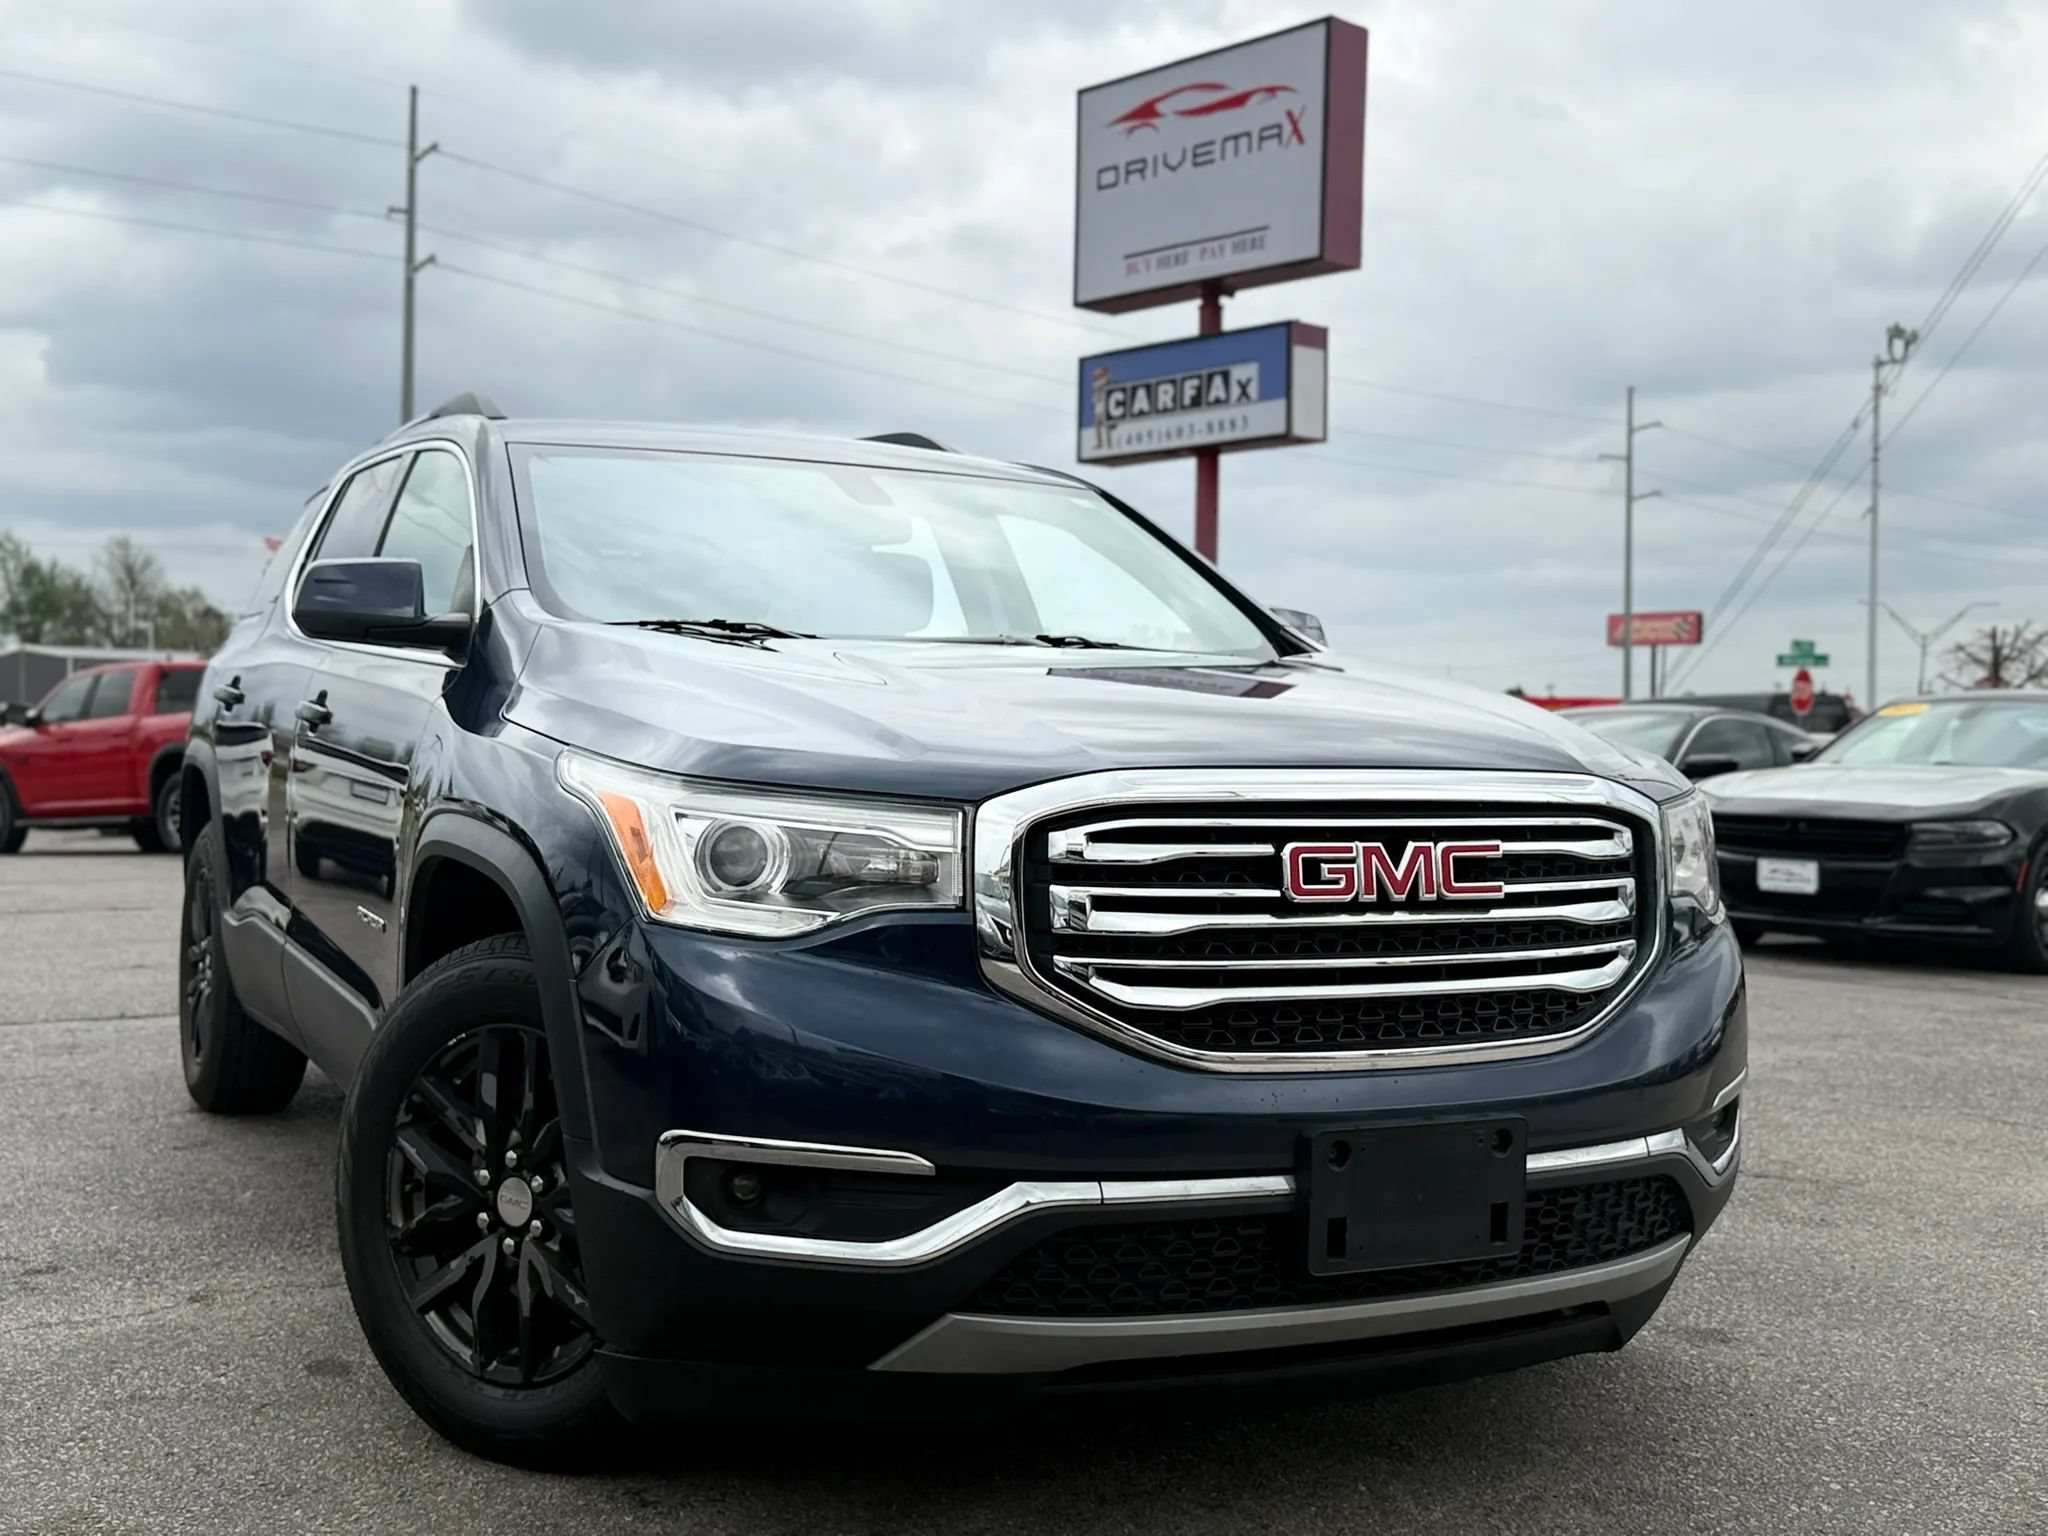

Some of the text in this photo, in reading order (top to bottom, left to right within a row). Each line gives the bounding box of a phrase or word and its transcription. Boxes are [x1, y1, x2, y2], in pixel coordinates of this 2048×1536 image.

[1096, 104, 1307, 191] DRIVEMAX
[1155, 250, 1190, 270] HERE
[1199, 242, 1226, 261] PAY
[1231, 234, 1266, 255] HERE
[1106, 371, 1254, 419] CARFAX
[1281, 840, 1504, 902] GMC
[500, 1194, 529, 1210] GMC
